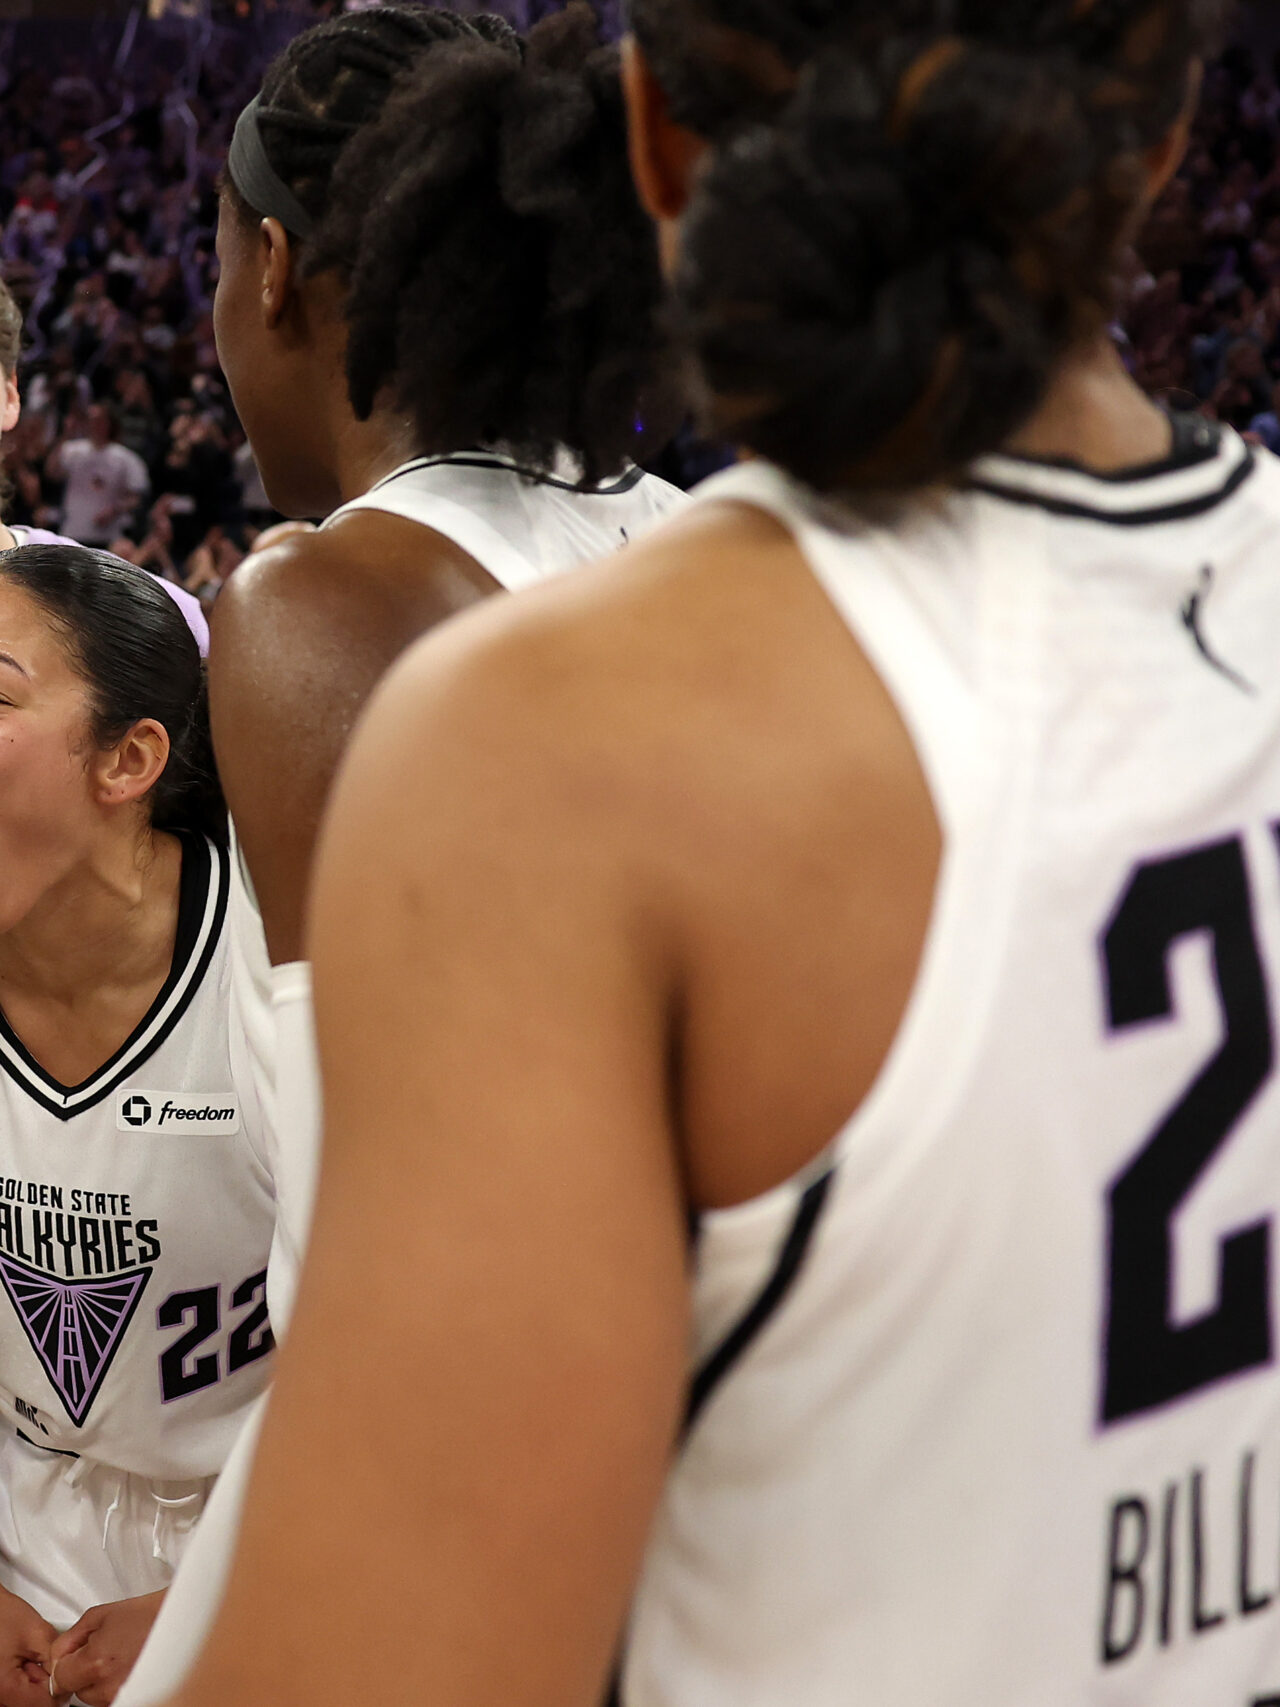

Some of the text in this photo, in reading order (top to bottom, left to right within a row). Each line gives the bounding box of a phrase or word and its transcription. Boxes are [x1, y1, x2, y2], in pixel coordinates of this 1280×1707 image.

[158, 1100, 235, 1125] freedom
[1096, 816, 1280, 1430] 2
[72, 1189, 131, 1215] STATE
[157, 1267, 275, 1404] 22
[1100, 1452, 1280, 1665] BILL
